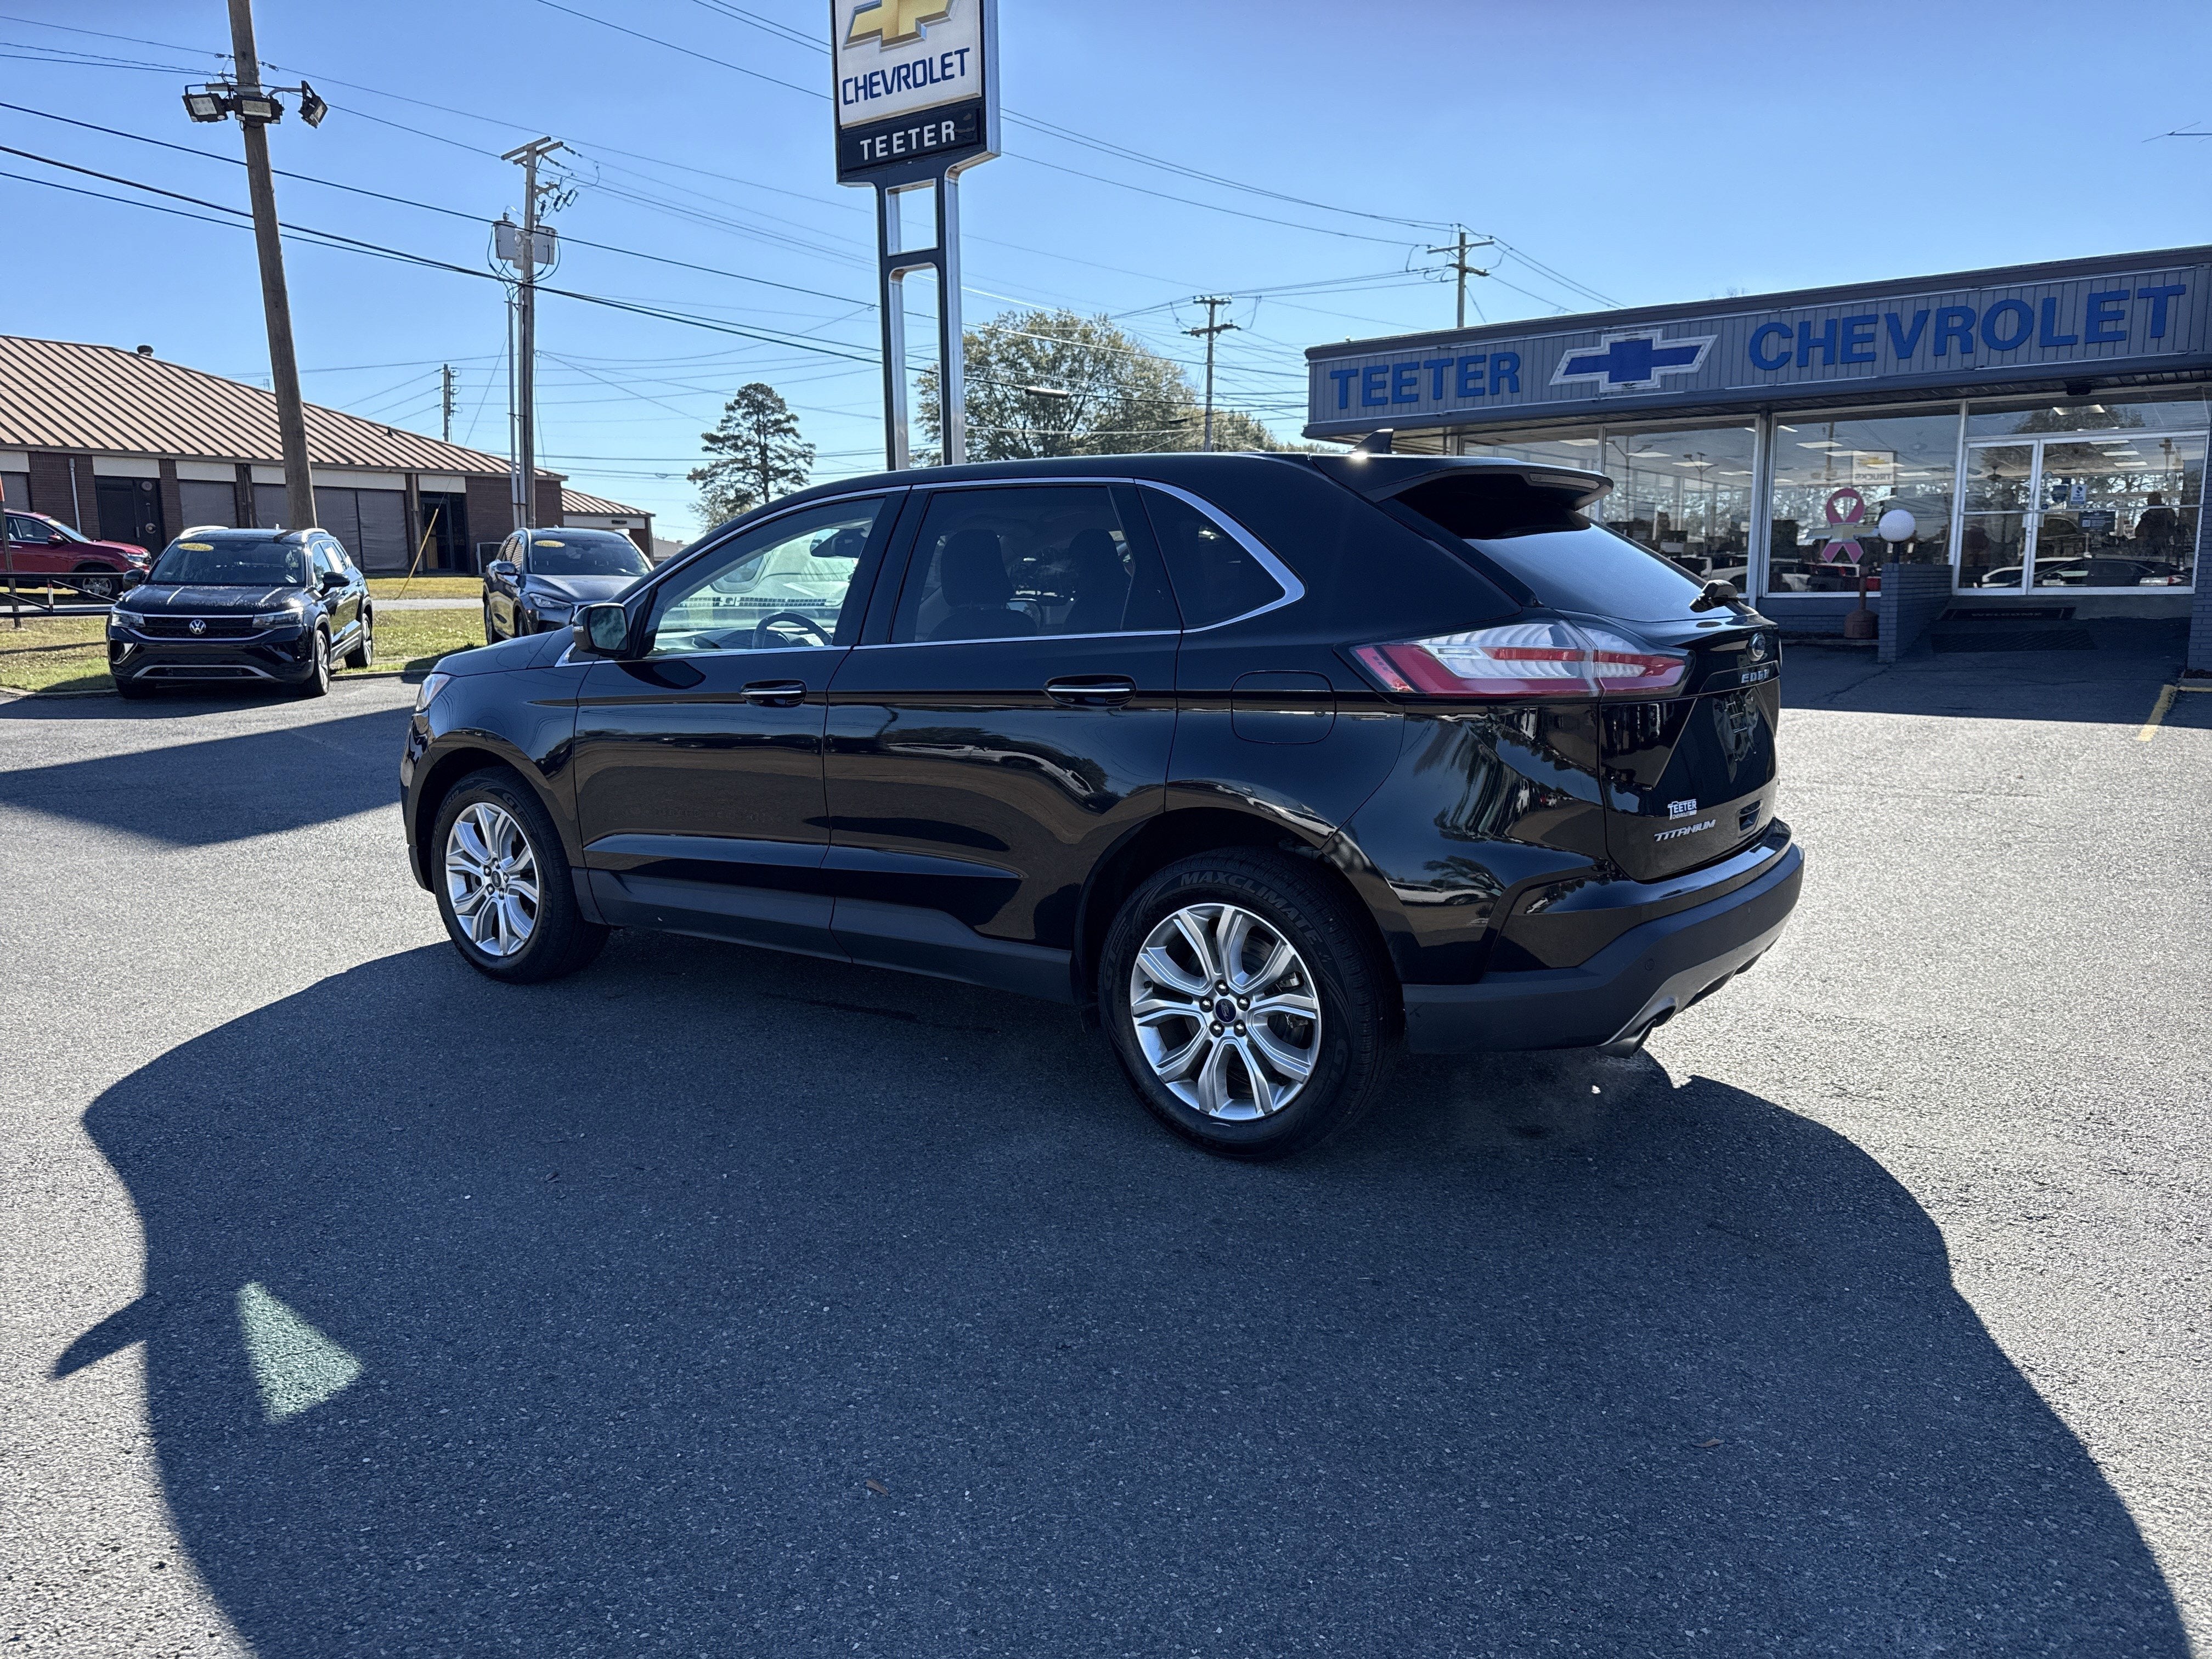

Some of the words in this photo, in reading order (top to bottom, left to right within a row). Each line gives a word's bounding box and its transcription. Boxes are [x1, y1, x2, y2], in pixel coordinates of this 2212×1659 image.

[842, 47, 970, 105] CHEVROLET
[860, 120, 955, 161] TEETER
[1330, 352, 1521, 409] TEETER
[1748, 284, 2187, 371] CHEVROLET
[1741, 669, 1770, 684] EDGE
[1654, 819, 1716, 842] TITANIUM
[1667, 800, 1697, 820] TEETER
[1181, 871, 1323, 945] MAXCLIMATE
